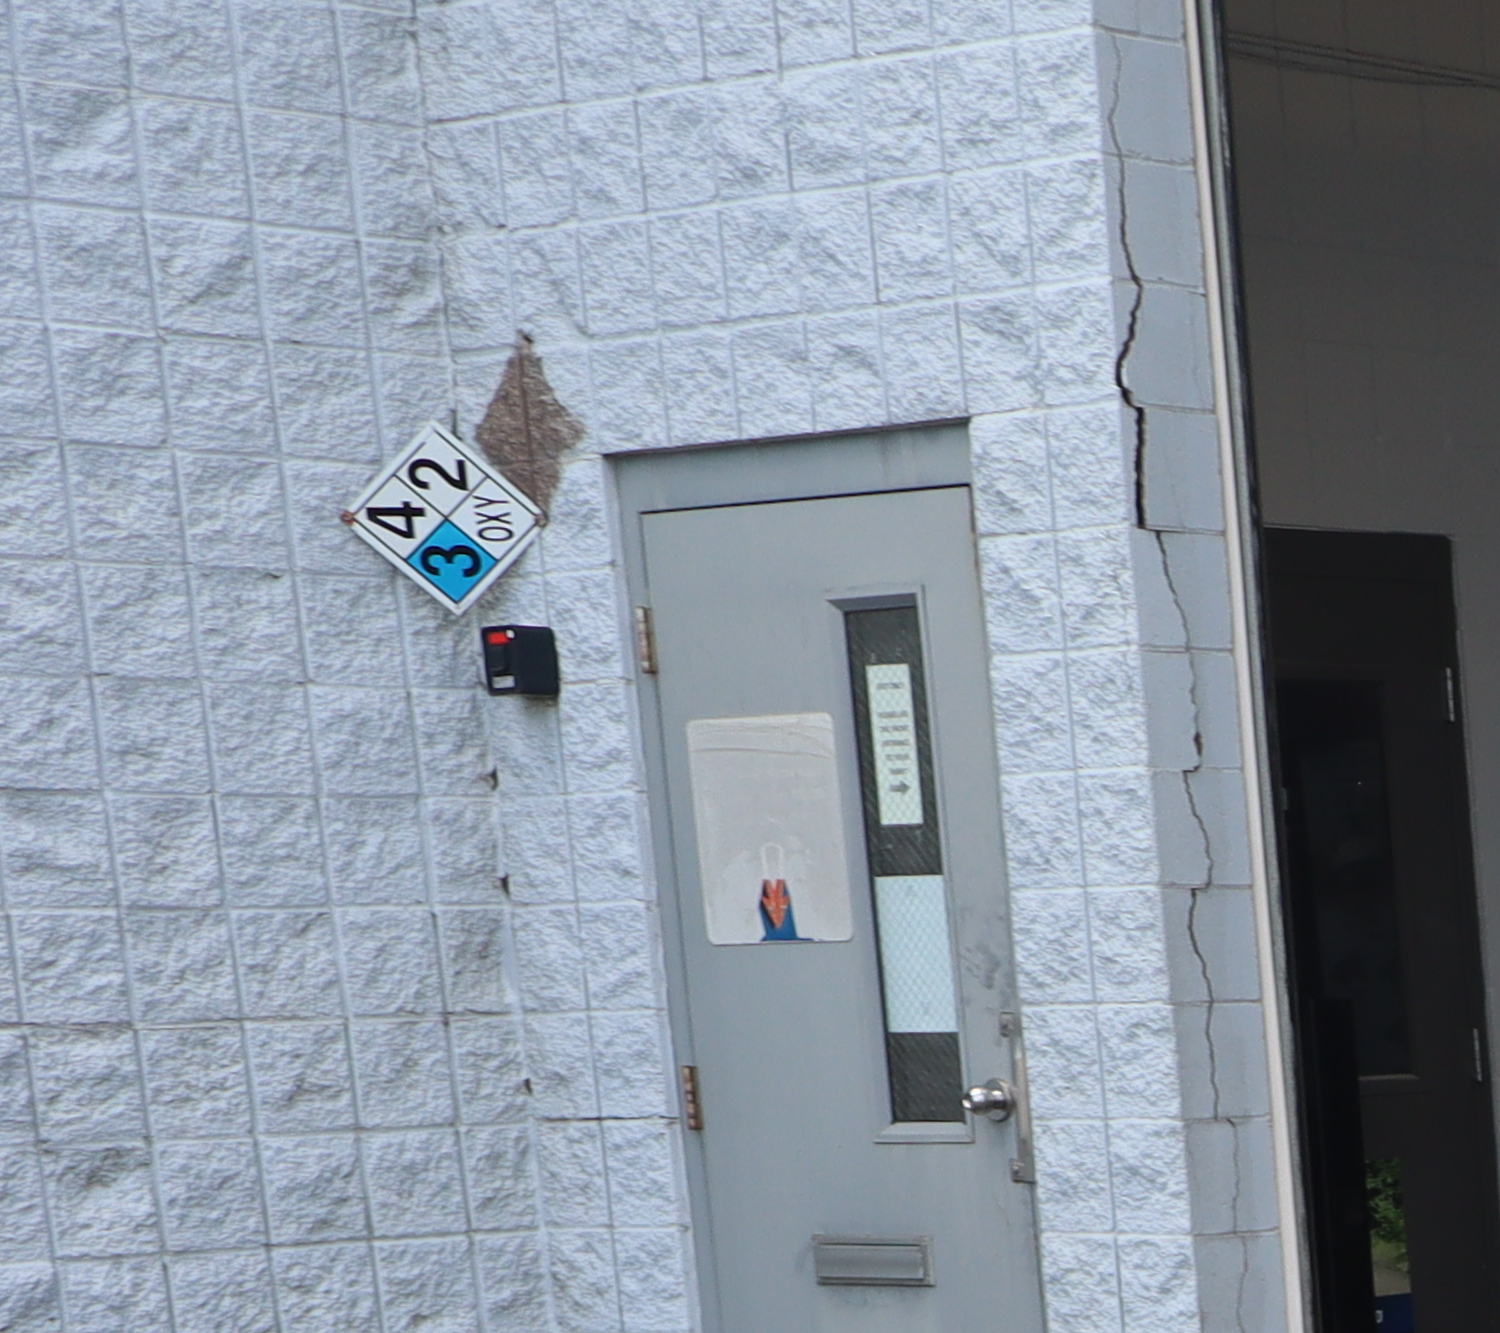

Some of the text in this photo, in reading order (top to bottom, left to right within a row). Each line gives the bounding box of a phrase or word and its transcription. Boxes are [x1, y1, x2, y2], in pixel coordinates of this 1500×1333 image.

[409, 459, 469, 491] 2
[366, 501, 425, 539] 4
[472, 495, 514, 542] OXY
[420, 545, 482, 578] 3
